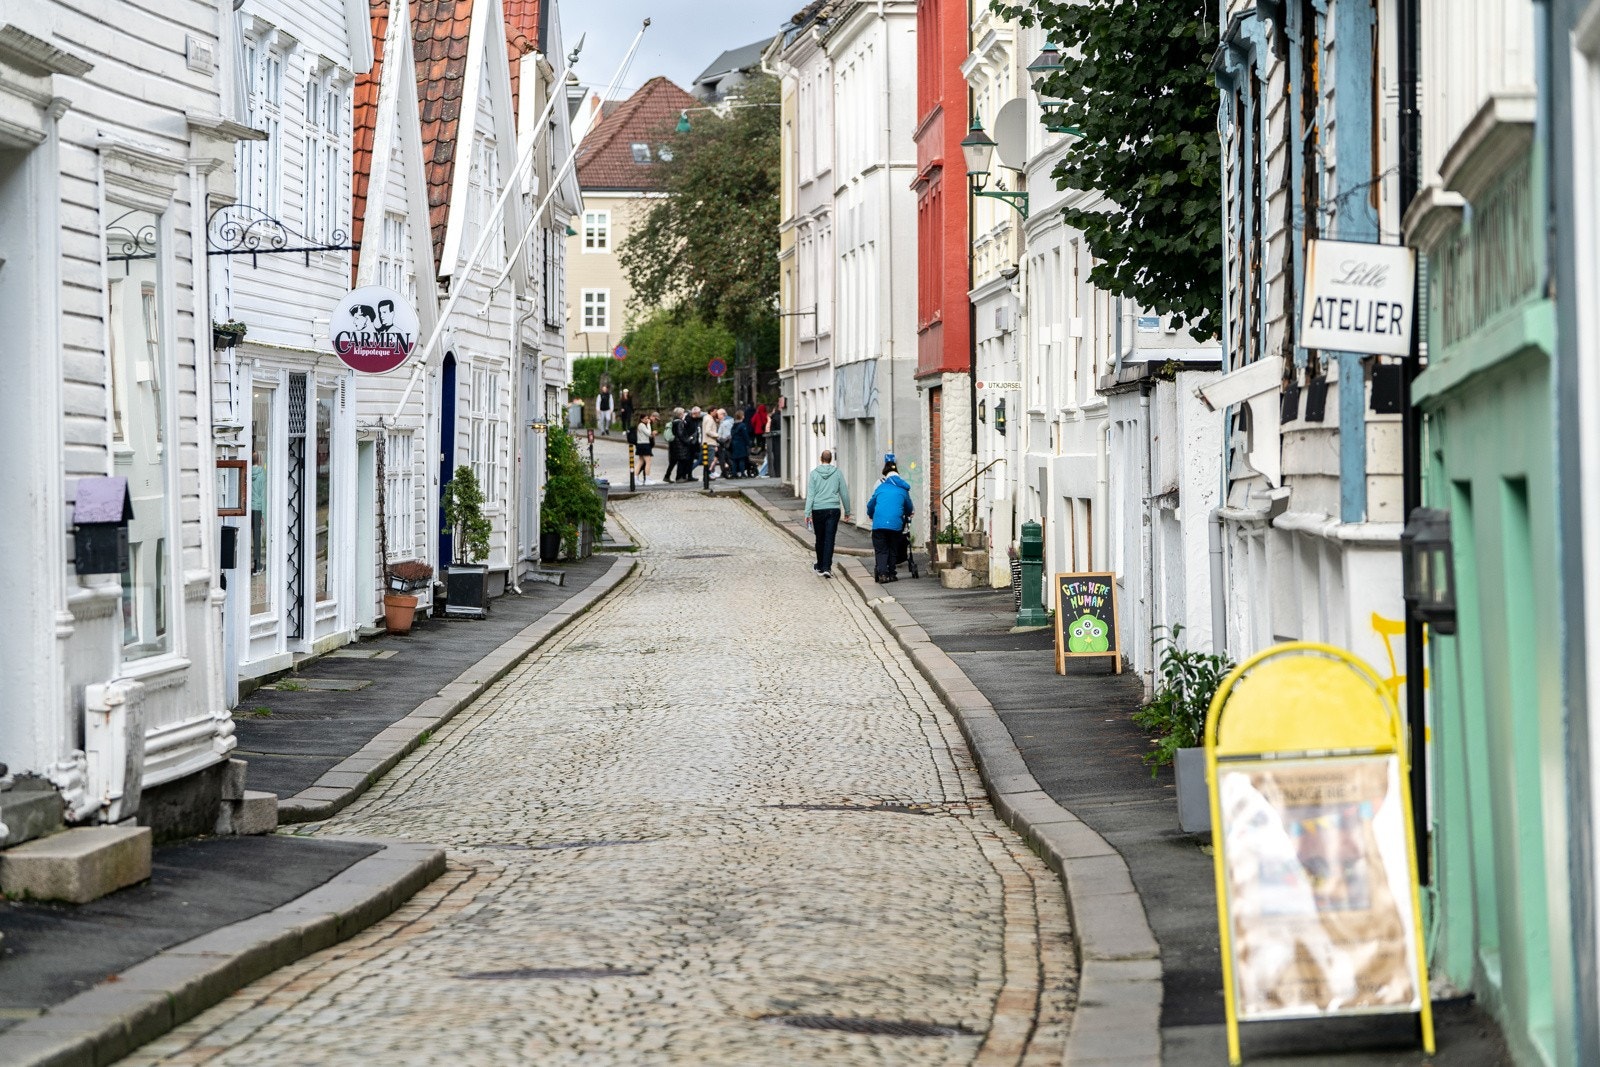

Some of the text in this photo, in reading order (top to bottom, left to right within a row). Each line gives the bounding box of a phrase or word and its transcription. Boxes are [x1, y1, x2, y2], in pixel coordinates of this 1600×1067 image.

[1330, 260, 1390, 287] Lille
[1310, 296, 1403, 335] ATELIER
[335, 331, 411, 354] CARMEN
[354, 347, 390, 356] klippoteque
[1062, 582, 1080, 596] GET
[1088, 582, 1110, 595] HERE
[1070, 595, 1104, 609] HUMAN
